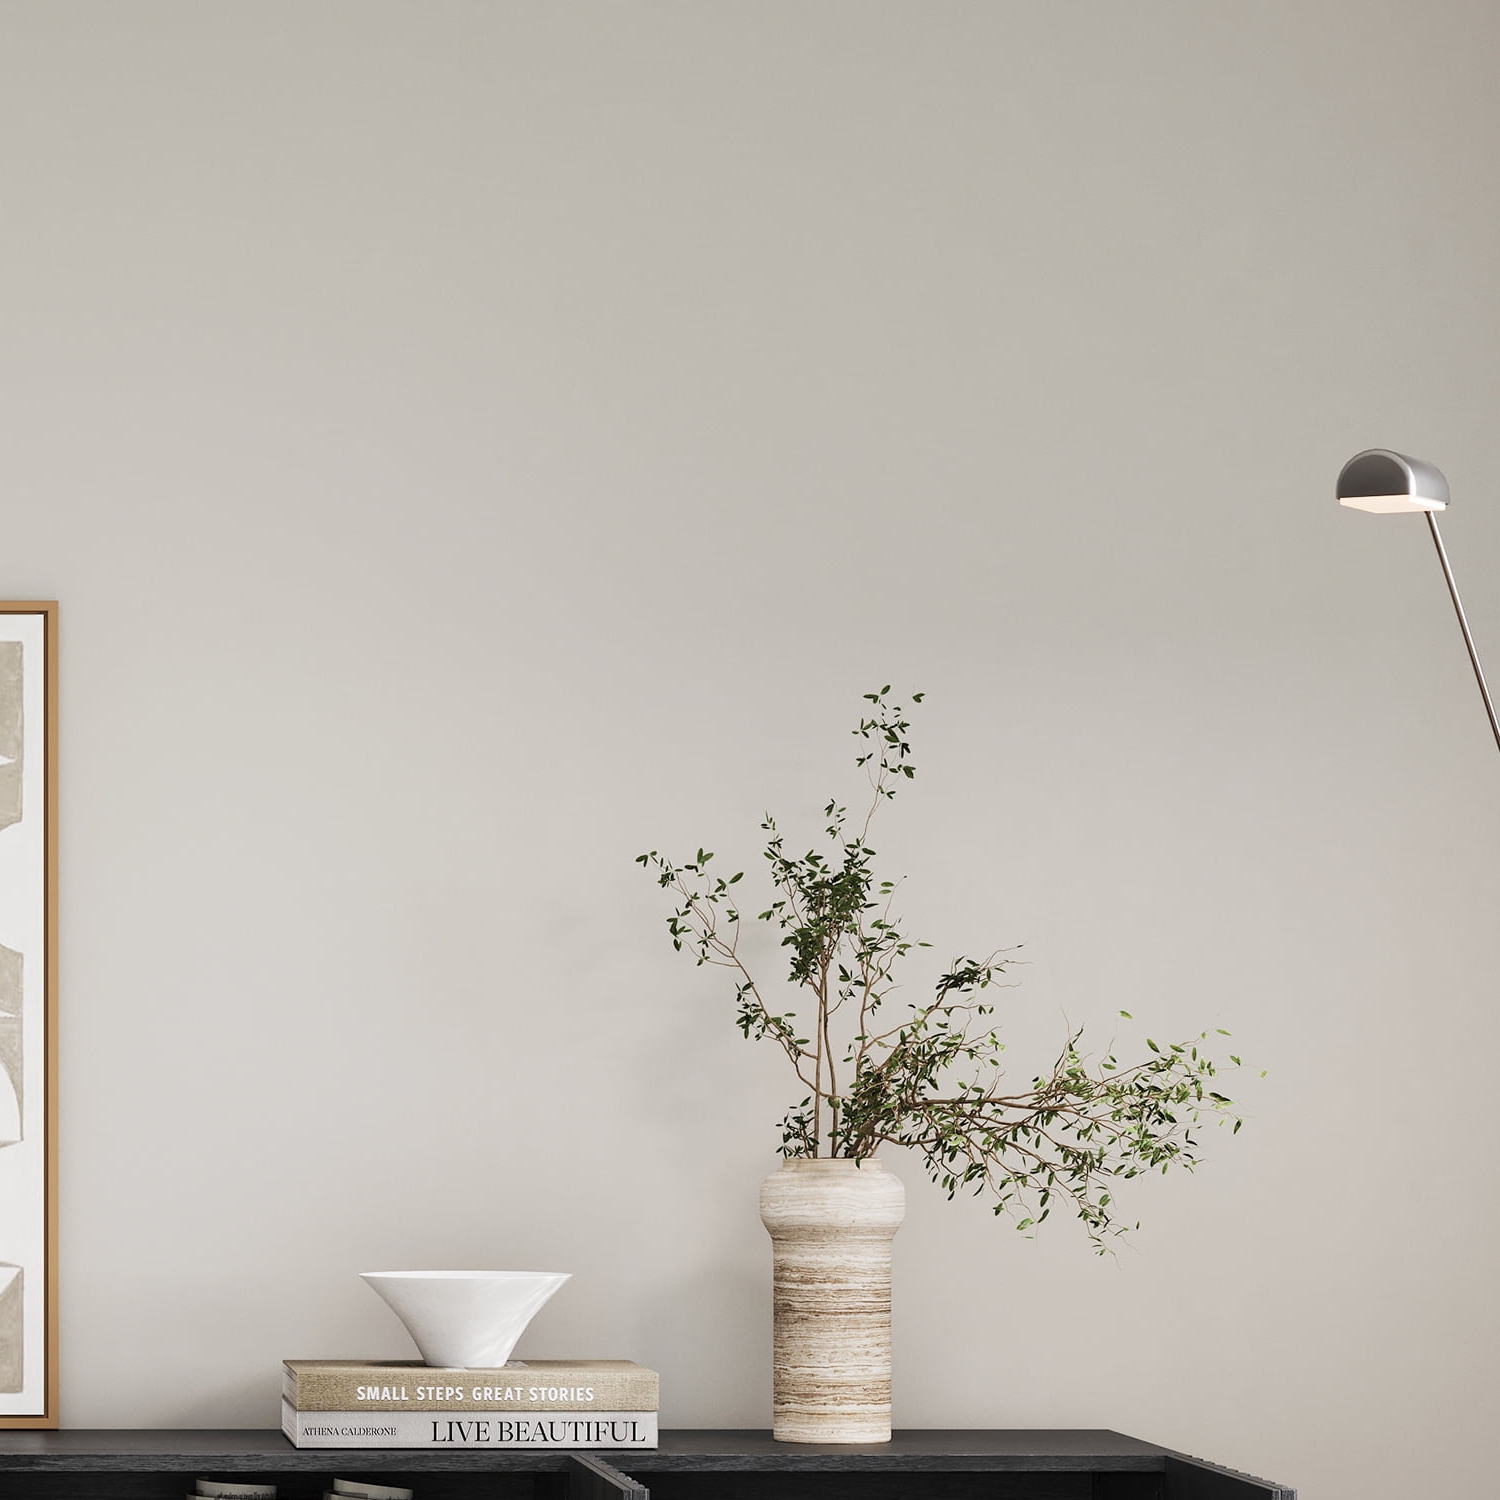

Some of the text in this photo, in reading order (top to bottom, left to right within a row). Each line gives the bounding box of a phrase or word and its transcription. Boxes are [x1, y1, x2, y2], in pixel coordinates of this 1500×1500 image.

[356, 1386, 594, 1402] SMALL STEPS GREAT STORIES
[302, 1427, 397, 1436] ATHENA CALDERONE
[431, 1421, 646, 1442] LIVE BEAUTIFUL
